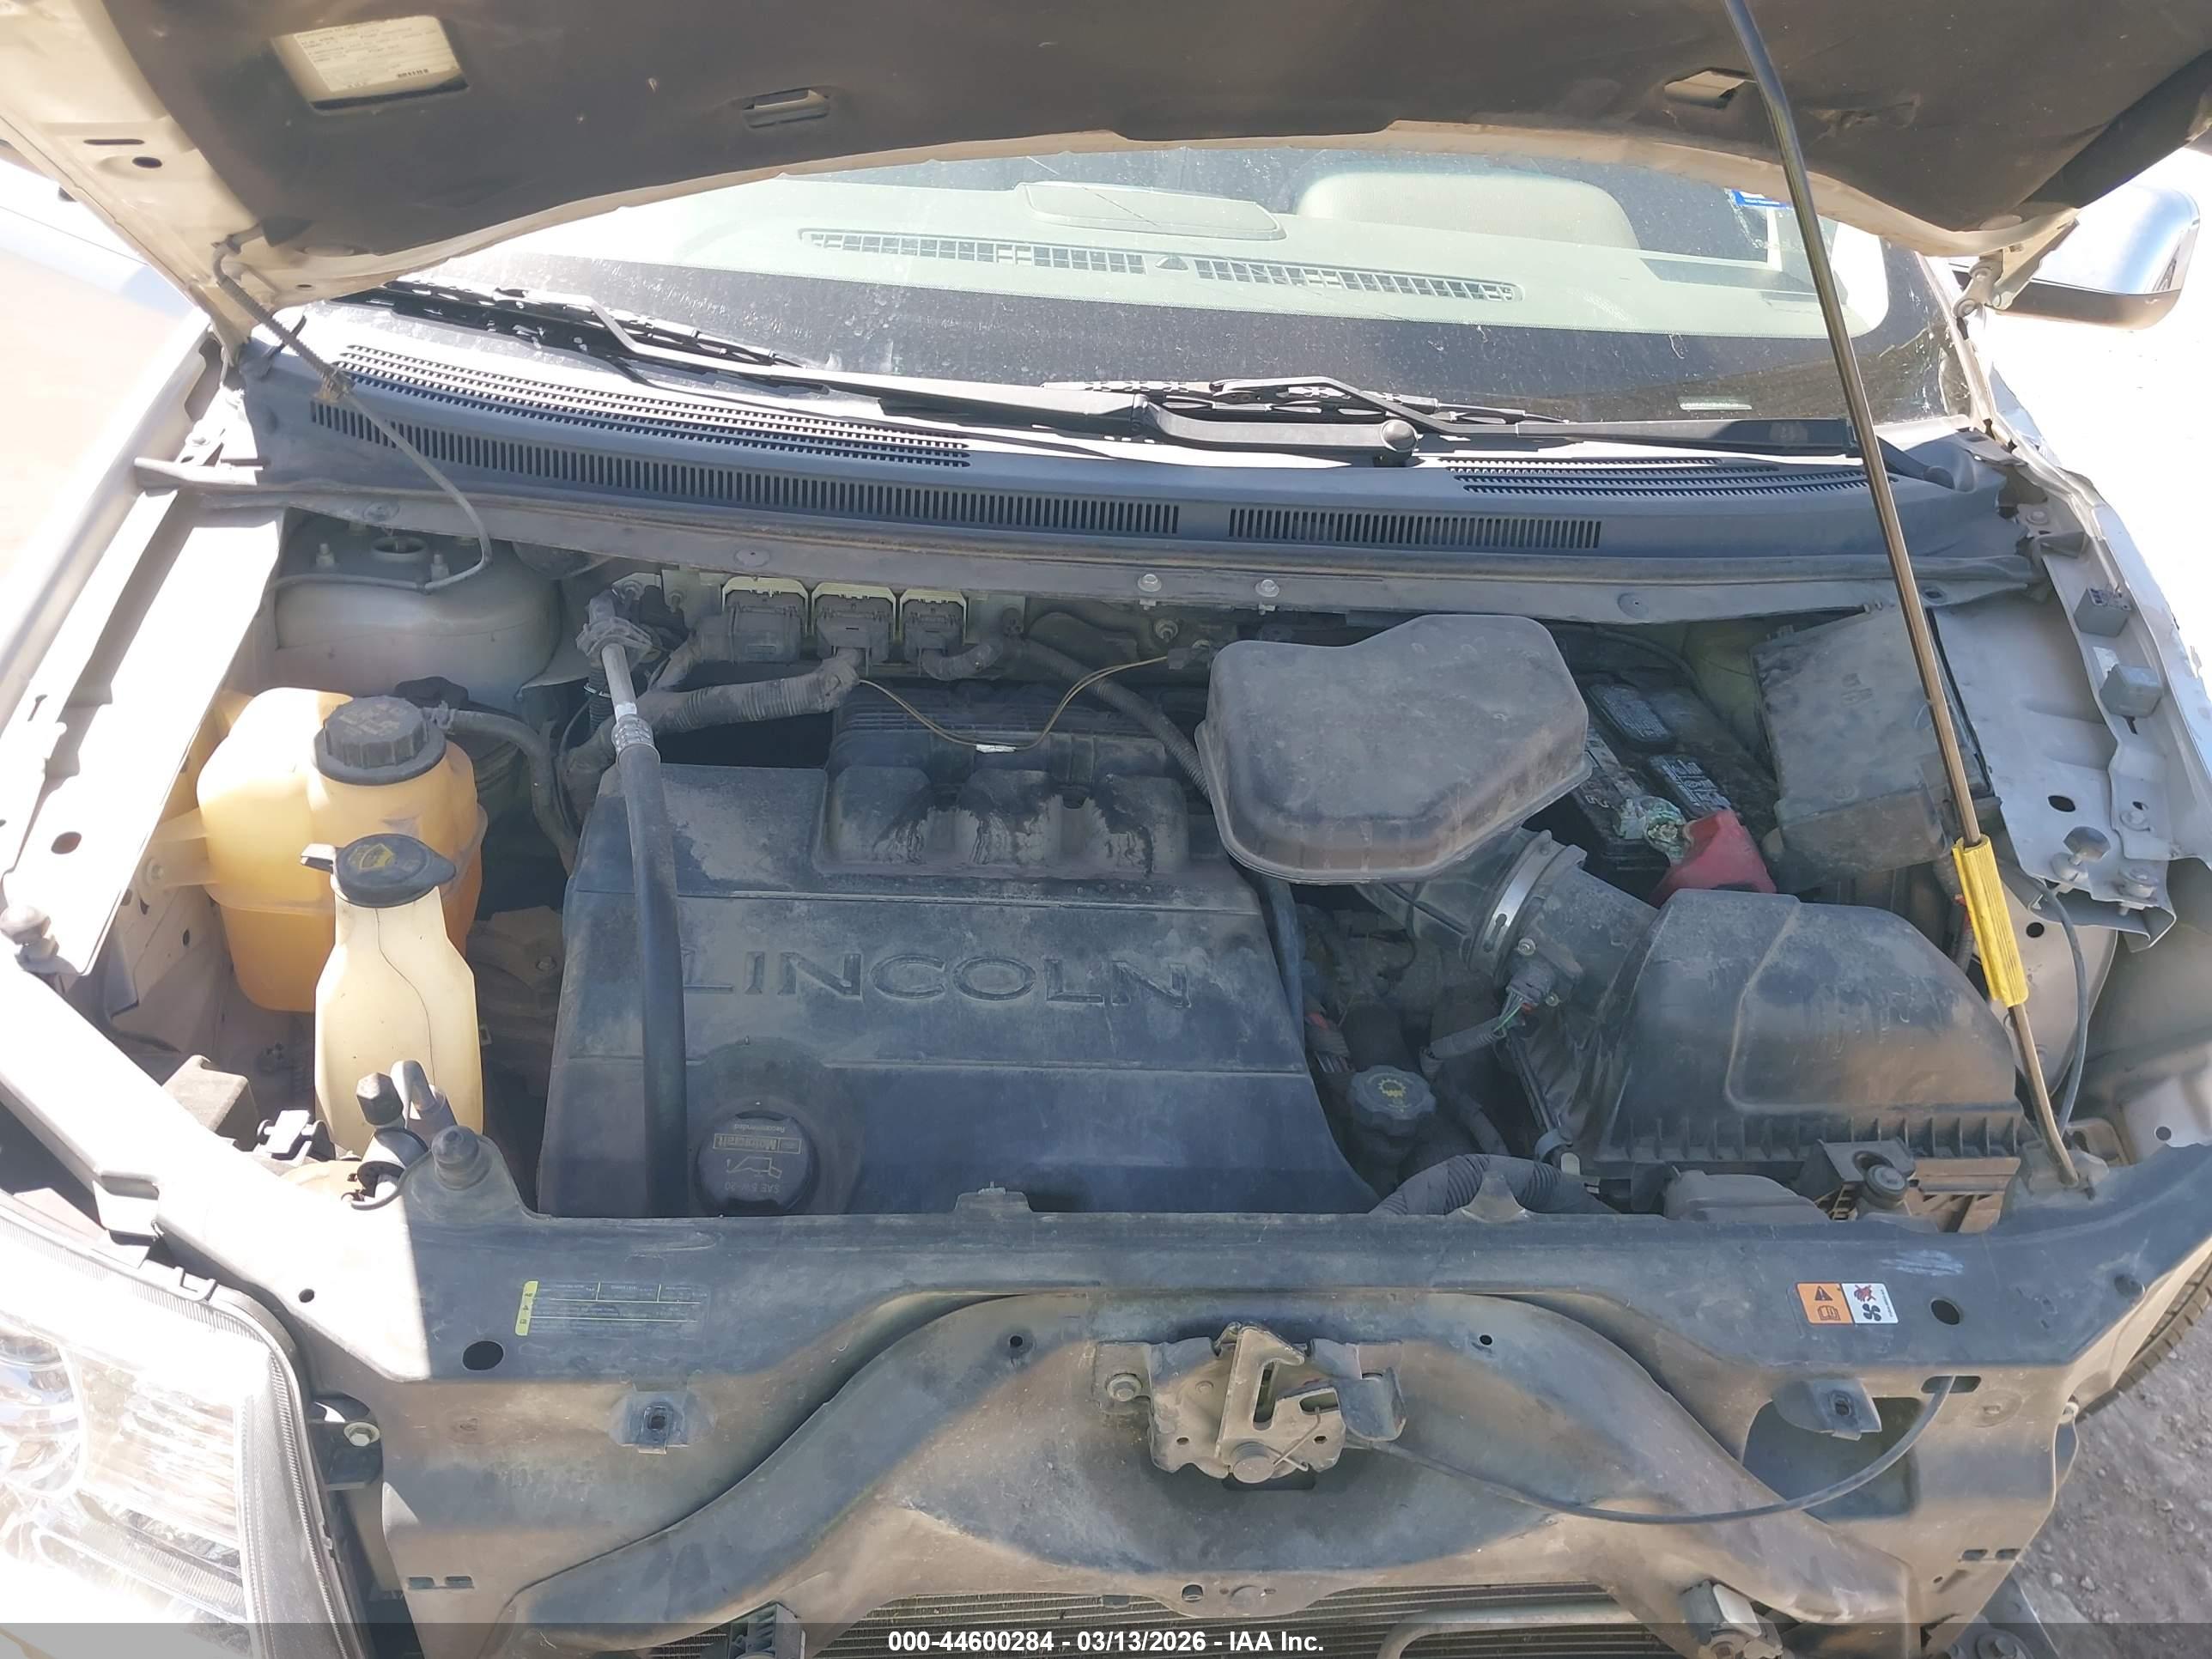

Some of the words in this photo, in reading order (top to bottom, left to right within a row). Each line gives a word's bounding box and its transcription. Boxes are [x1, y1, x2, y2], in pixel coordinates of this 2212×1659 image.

[683, 947, 1191, 1008] LINCOLN
[719, 1136, 778, 1151] Motorcraft
[761, 1182, 781, 1194] SAE
